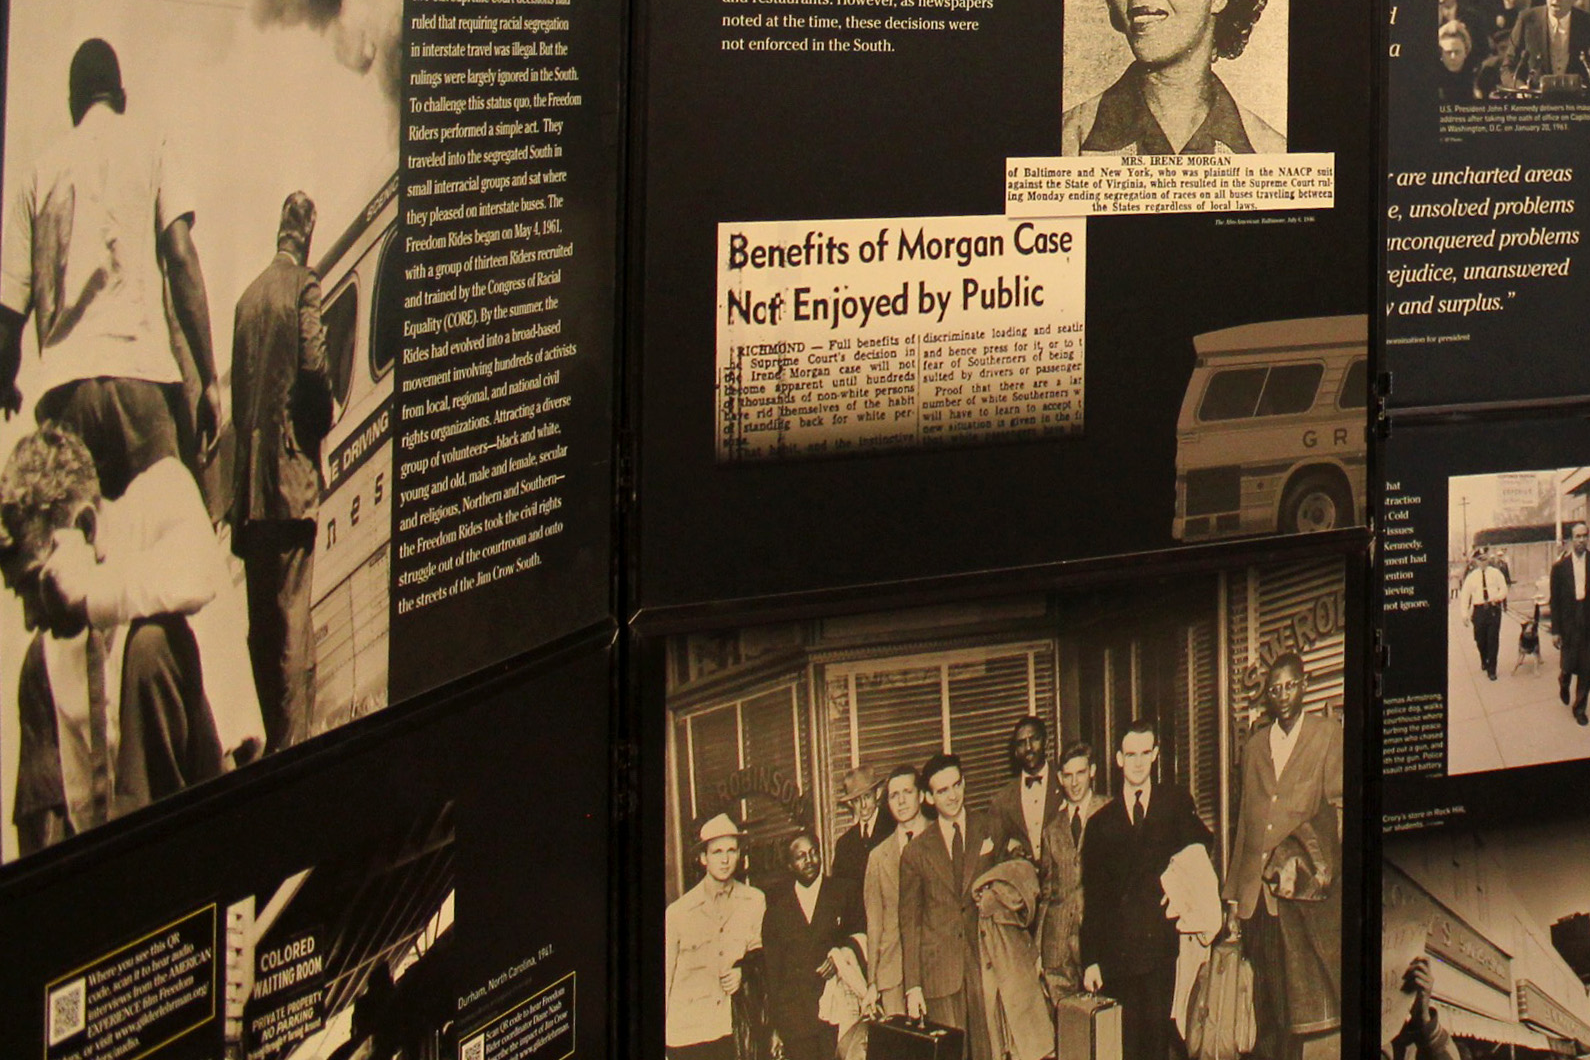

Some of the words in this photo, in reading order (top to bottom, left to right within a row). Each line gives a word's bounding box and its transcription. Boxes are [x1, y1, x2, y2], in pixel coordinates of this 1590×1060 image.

[1121, 154, 1145, 166] MRS.
[1150, 154, 1183, 166] IRENE
[1187, 155, 1232, 166] MORGAN
[1007, 168, 1019, 179] of
[1024, 167, 1072, 178] Baltimore
[1077, 167, 1095, 177] and
[1100, 167, 1122, 177] New
[1127, 167, 1153, 178] York,
[1158, 167, 1177, 177] who
[1182, 169, 1199, 177] was
[1204, 167, 1240, 179] plaintiff
[1245, 167, 1254, 177] in
[1259, 167, 1274, 177] the
[1278, 167, 1312, 177] NAACP
[1317, 168, 1333, 178] suit
[1396, 172, 1427, 186] are
[1432, 165, 1521, 185] uncharted
[1524, 168, 1572, 183] areas
[1409, 198, 1490, 218] unsolved
[1493, 196, 1574, 219] problems
[729, 232, 849, 270] Benefits
[859, 228, 889, 263] of
[898, 227, 1004, 266] Morgan
[1013, 222, 1073, 257] Case
[1387, 229, 1495, 252] nconquered
[1498, 227, 1579, 250] problems
[1387, 263, 1456, 287] ejudice,
[1464, 258, 1570, 280] unanswered
[727, 290, 784, 326] Not
[794, 283, 909, 325] Enjoyed
[918, 281, 951, 321] by
[962, 275, 1044, 310] Public
[1398, 294, 1433, 315] and
[343, 411, 389, 470] DRIVING
[261, 936, 315, 972] COLORED
[254, 967, 295, 999] WAITING
[296, 956, 322, 980] ROOM
[487, 972, 508, 991] North
